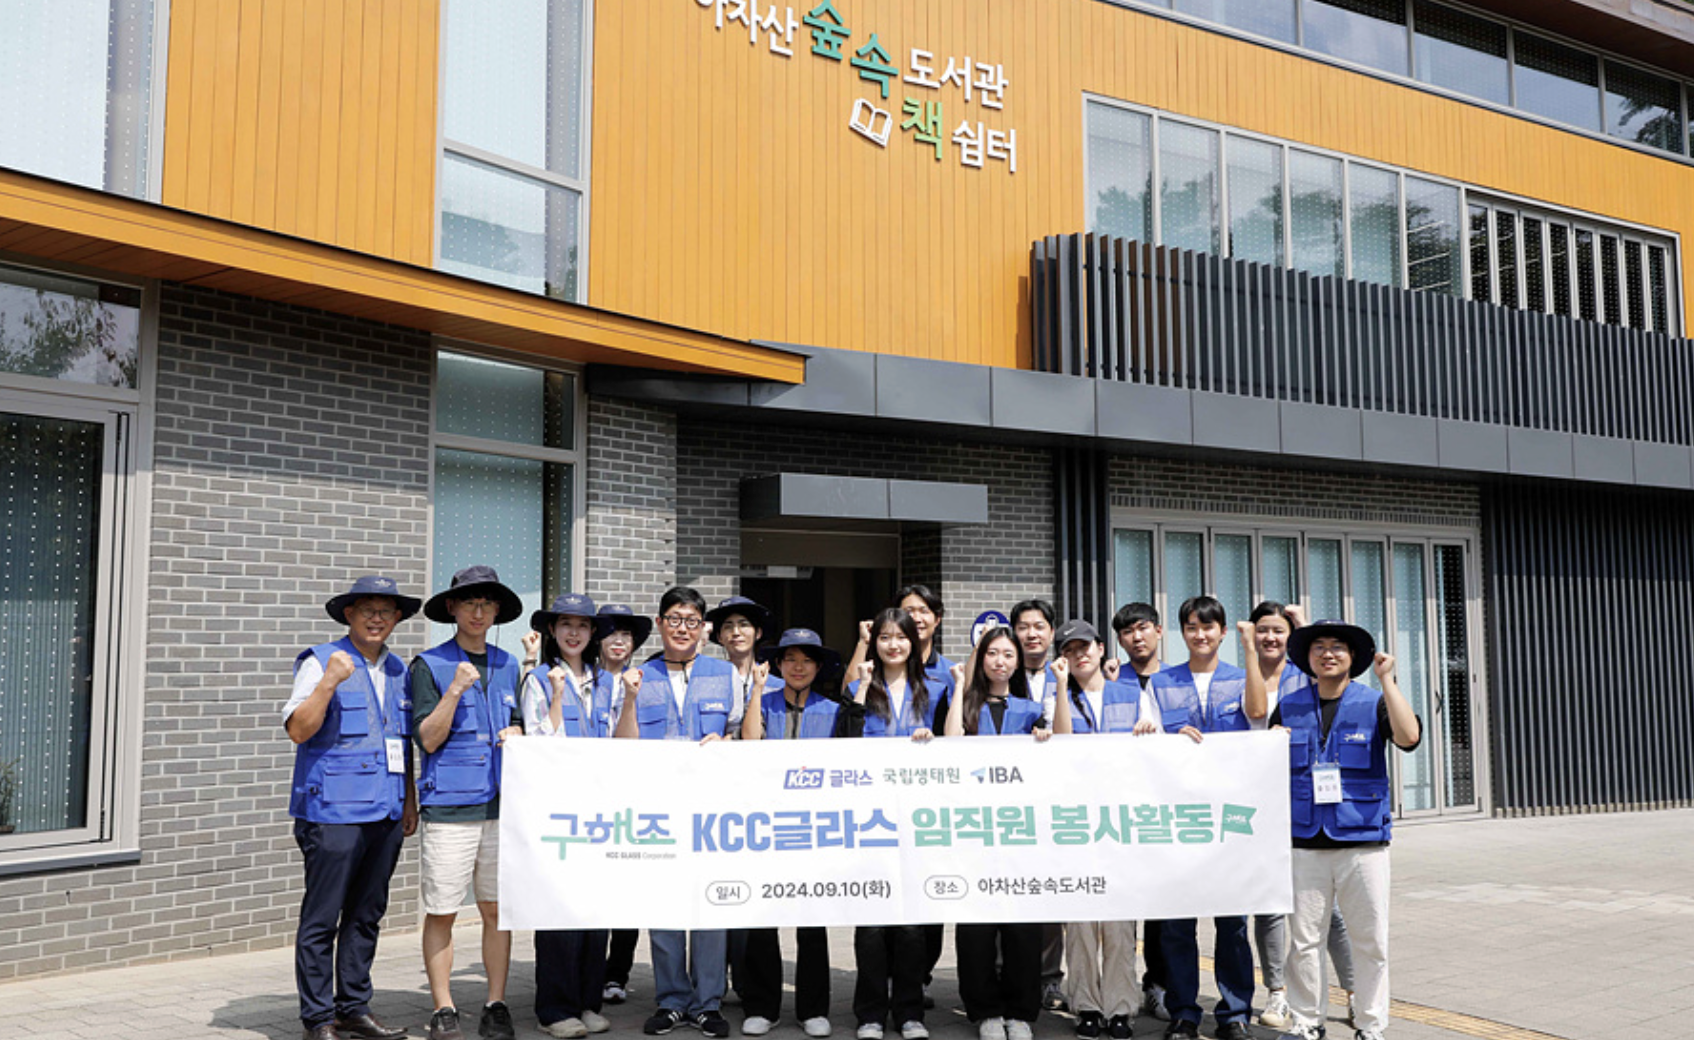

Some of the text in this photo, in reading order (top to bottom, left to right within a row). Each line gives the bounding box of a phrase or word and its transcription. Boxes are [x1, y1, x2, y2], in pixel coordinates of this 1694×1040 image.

[903, 48, 1009, 109] 도서관
[900, 96, 1017, 174] 책 쉼터
[784, 768, 873, 789] KCC 글라스
[882, 767, 960, 786] 국립생태원
[988, 765, 1024, 784] IBA
[540, 803, 1214, 861] 구해조 KCC글라스 임직원 봉사활동
[715, 879, 892, 901] 일시 2024.09.10(화)
[933, 876, 1107, 896] 장소 아차산숲속도서관
